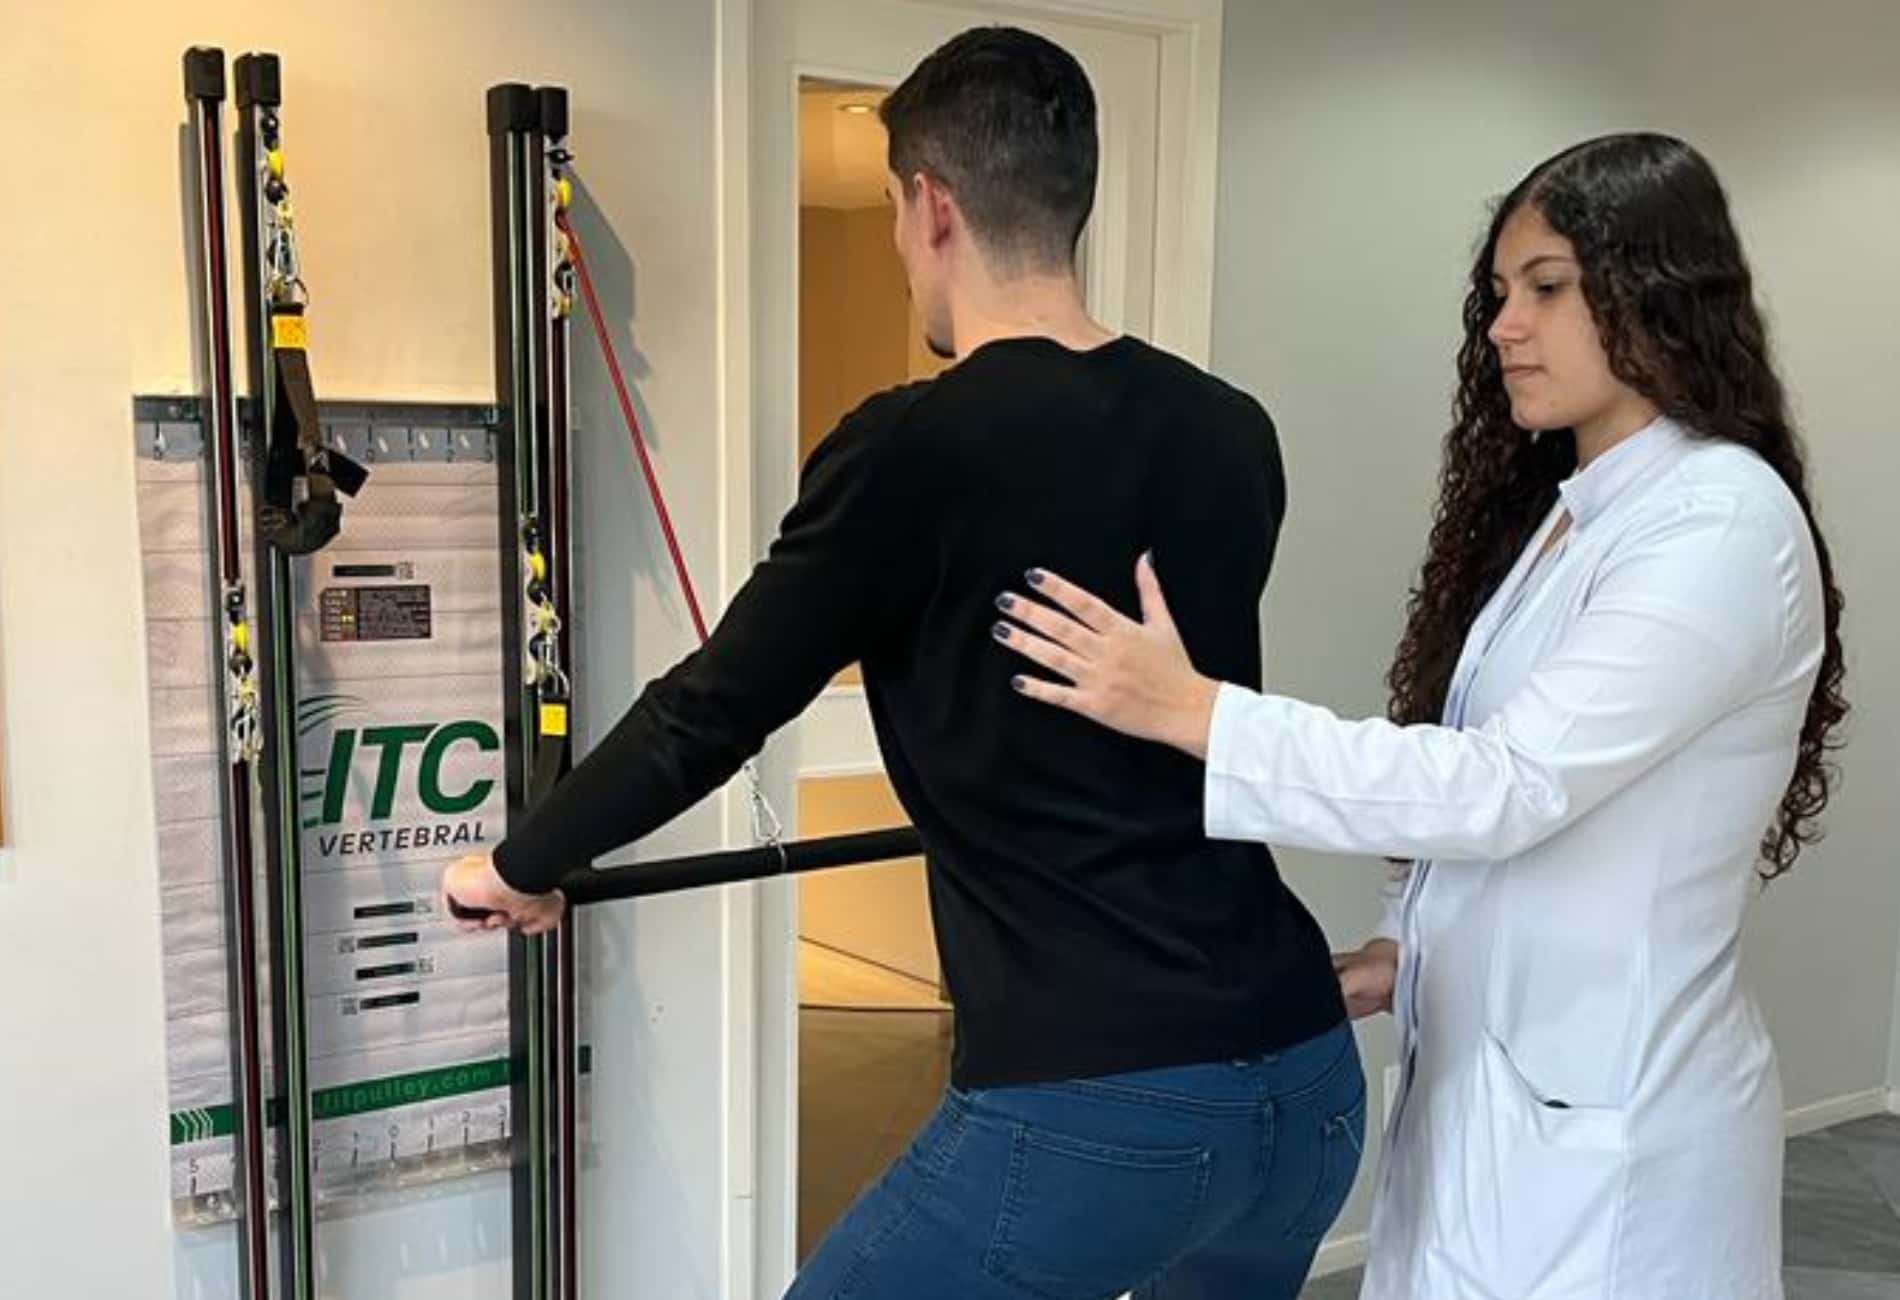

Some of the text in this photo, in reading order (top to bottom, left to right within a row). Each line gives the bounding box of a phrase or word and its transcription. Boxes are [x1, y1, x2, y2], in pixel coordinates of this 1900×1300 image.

[322, 720, 500, 824] ITC
[319, 821, 486, 857] VERTEBRAL
[189, 1157, 199, 1174] 5
[389, 1123, 398, 1136] 0
[462, 1110, 471, 1124] 2
[499, 1104, 508, 1118] 3
